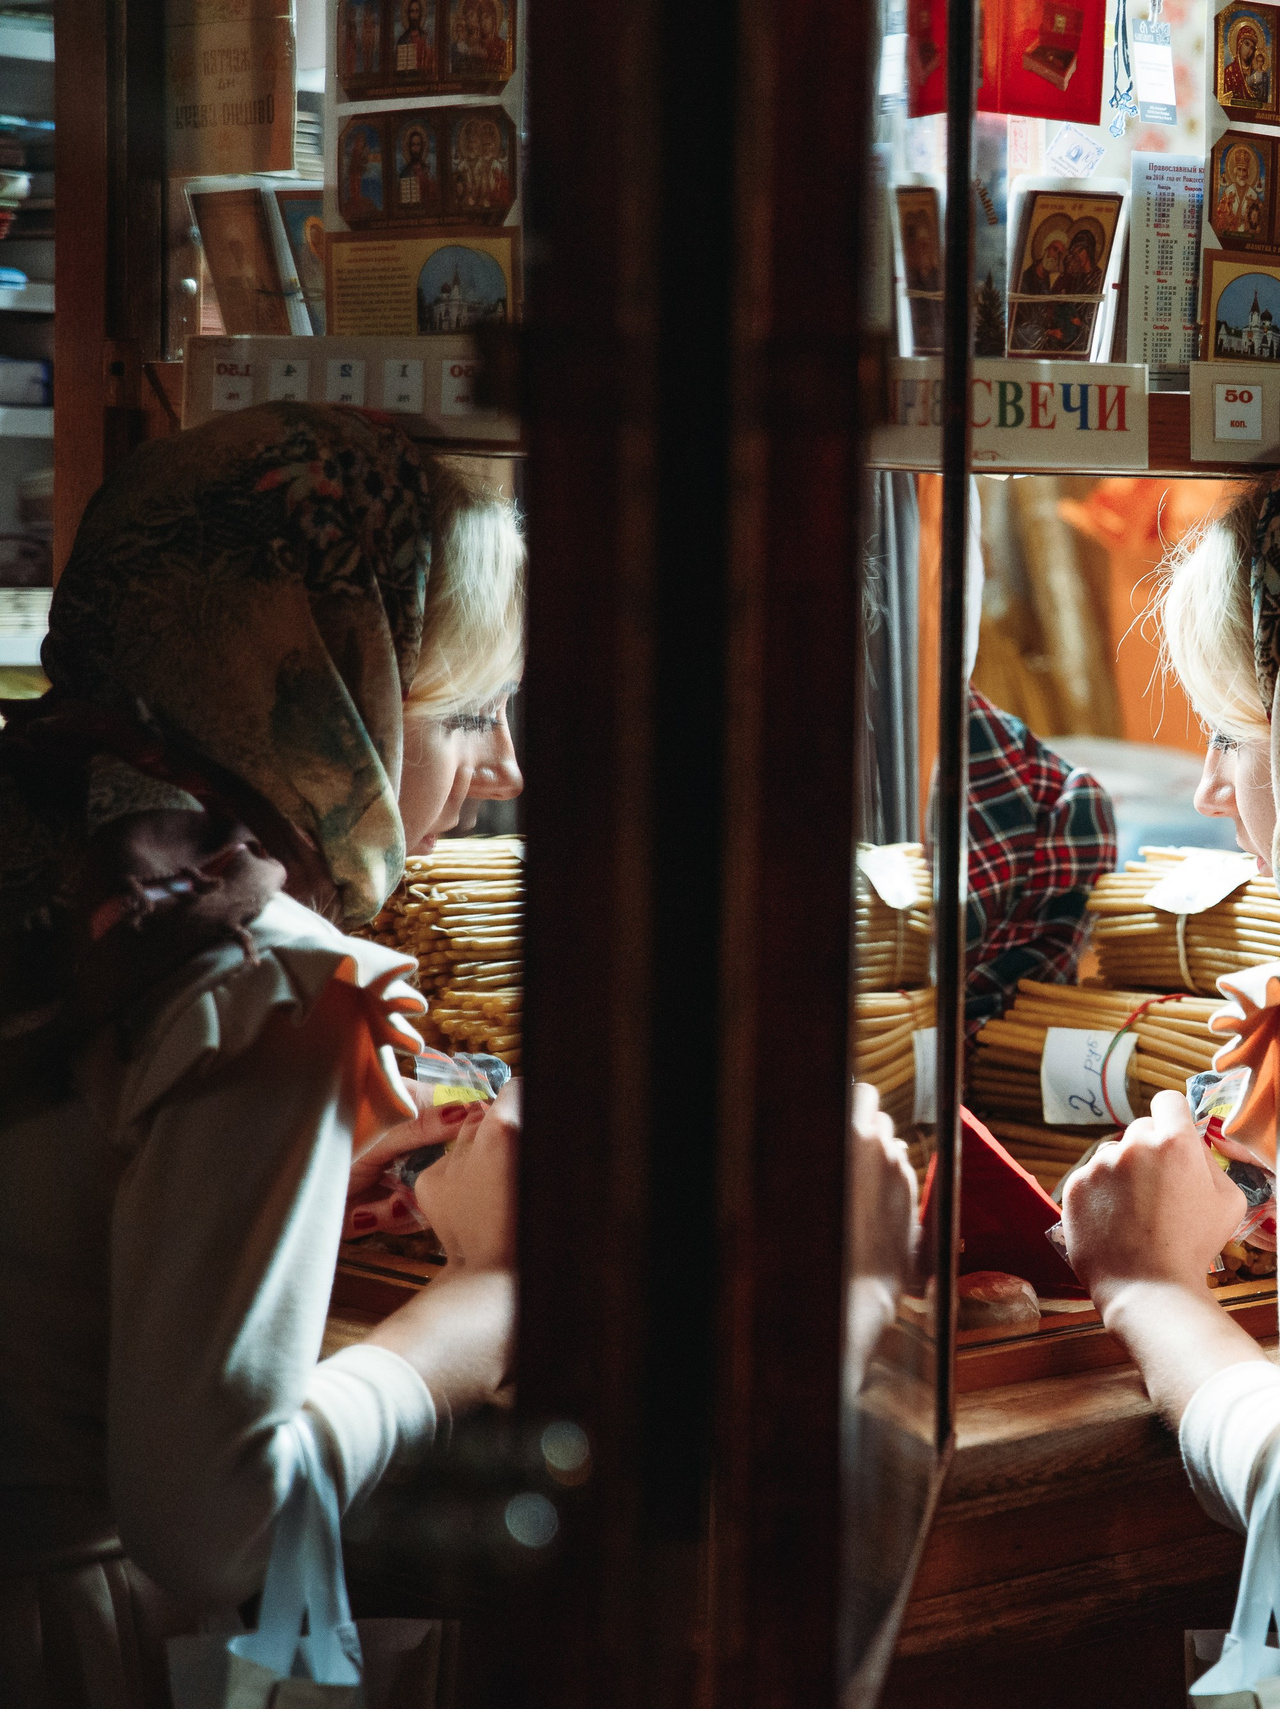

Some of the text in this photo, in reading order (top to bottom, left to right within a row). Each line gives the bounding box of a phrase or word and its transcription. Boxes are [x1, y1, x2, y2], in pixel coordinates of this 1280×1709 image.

[1224, 390, 1253, 403] 50
[969, 378, 1130, 432] СВЕЧИ
[1230, 420, 1247, 428] КОП.
